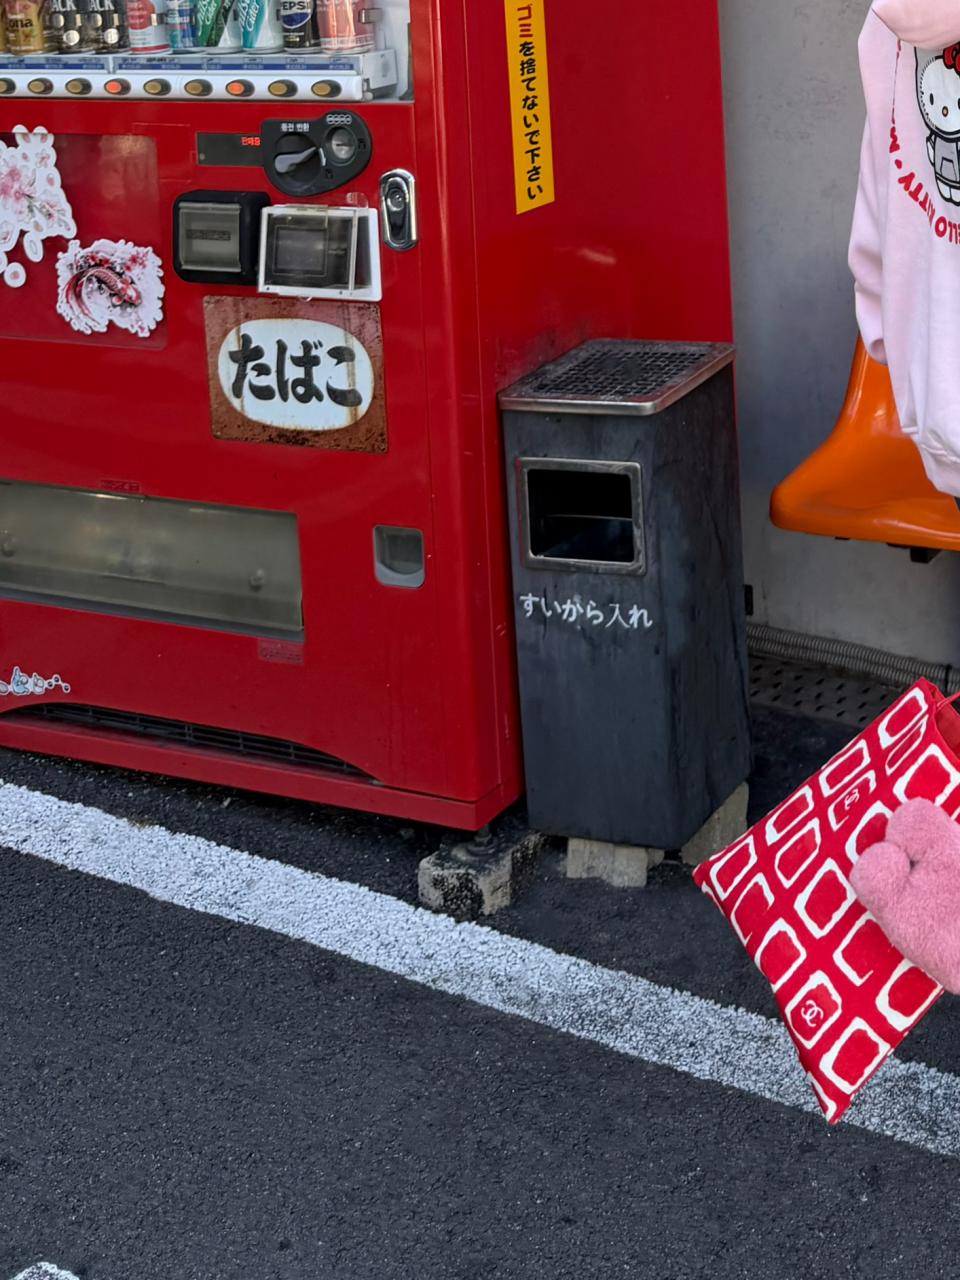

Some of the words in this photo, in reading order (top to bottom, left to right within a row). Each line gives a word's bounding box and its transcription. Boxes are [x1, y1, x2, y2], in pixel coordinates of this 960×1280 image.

[517, 3, 543, 200] ゴミを捨てないで下さい
[229, 333, 363, 407] たばこ
